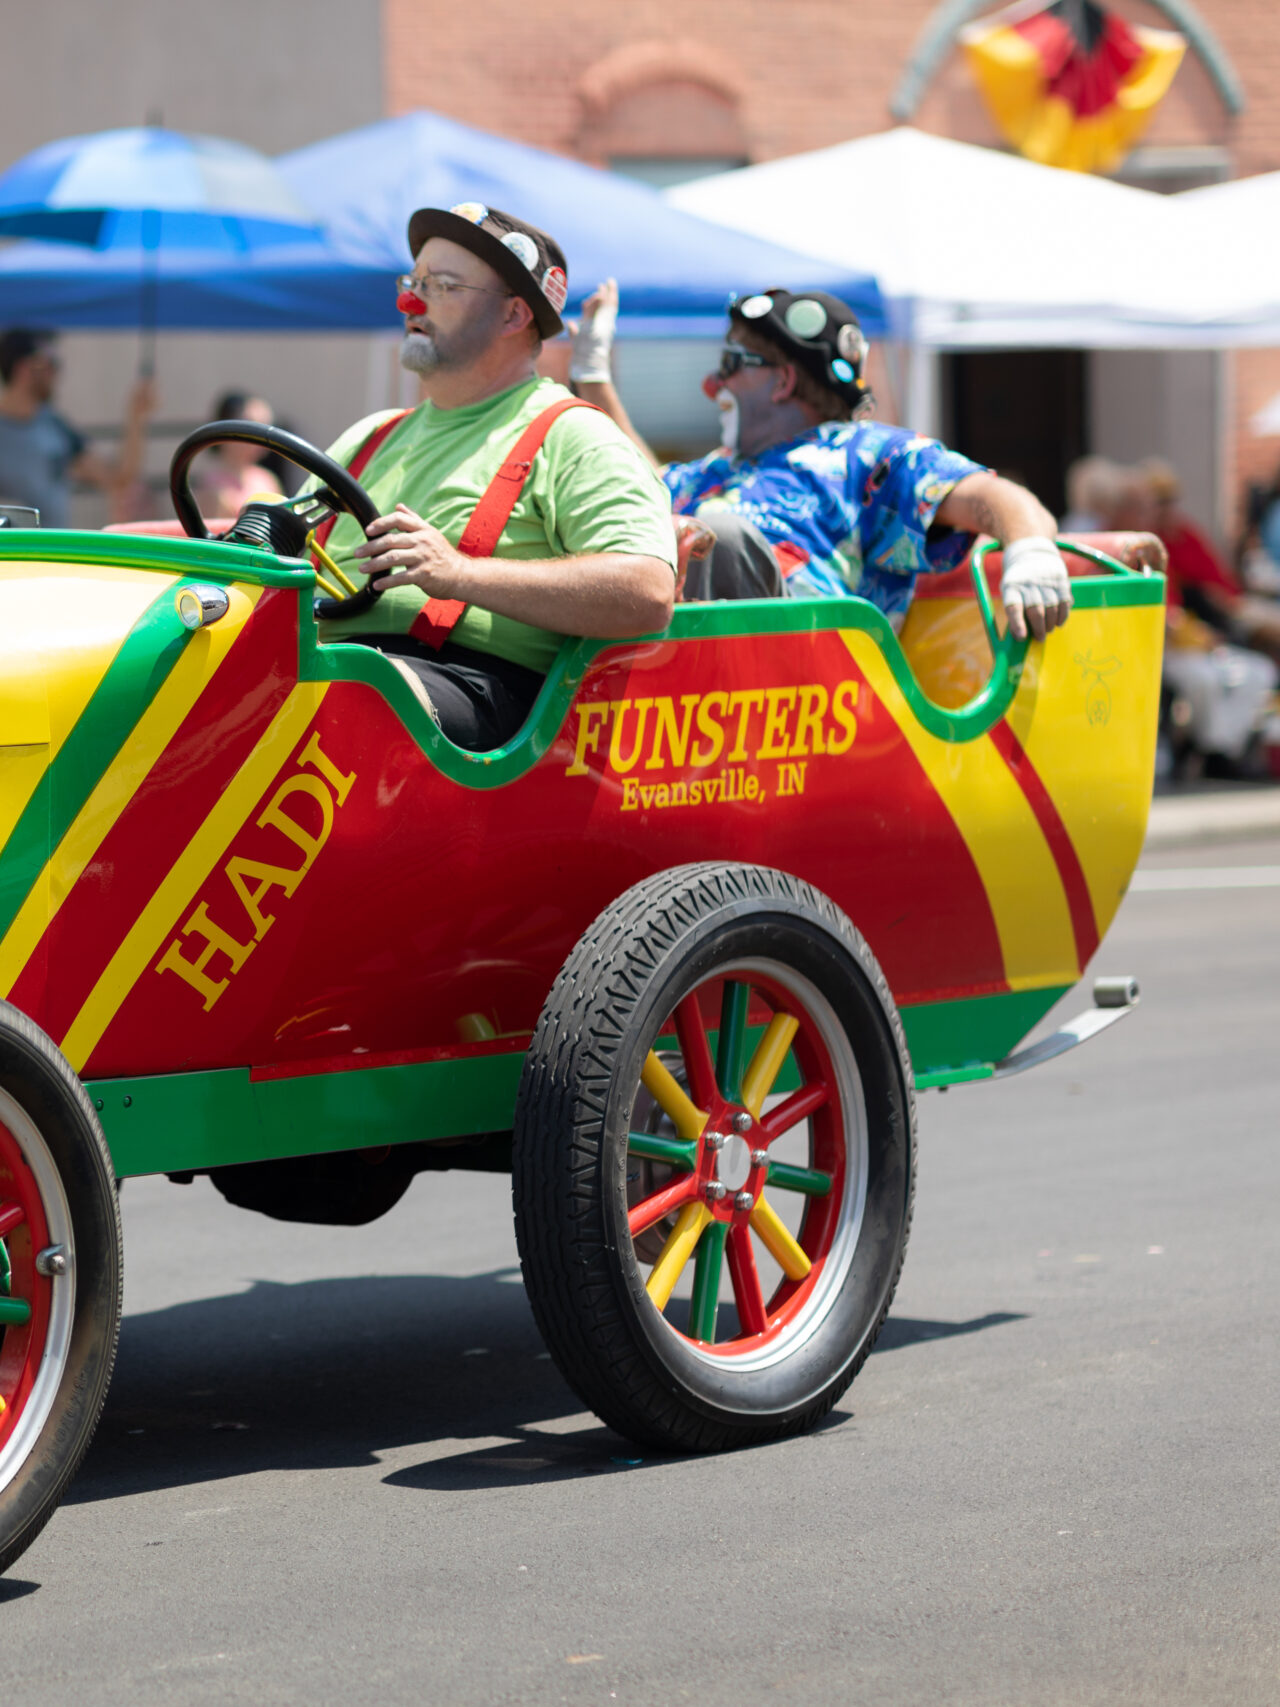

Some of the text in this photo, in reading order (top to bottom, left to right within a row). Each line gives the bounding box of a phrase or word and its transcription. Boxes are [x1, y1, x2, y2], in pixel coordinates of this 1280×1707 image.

[565, 679, 860, 777] FUNSTERS
[620, 761, 808, 811] Evansville, IN
[154, 730, 358, 1013] HADI
